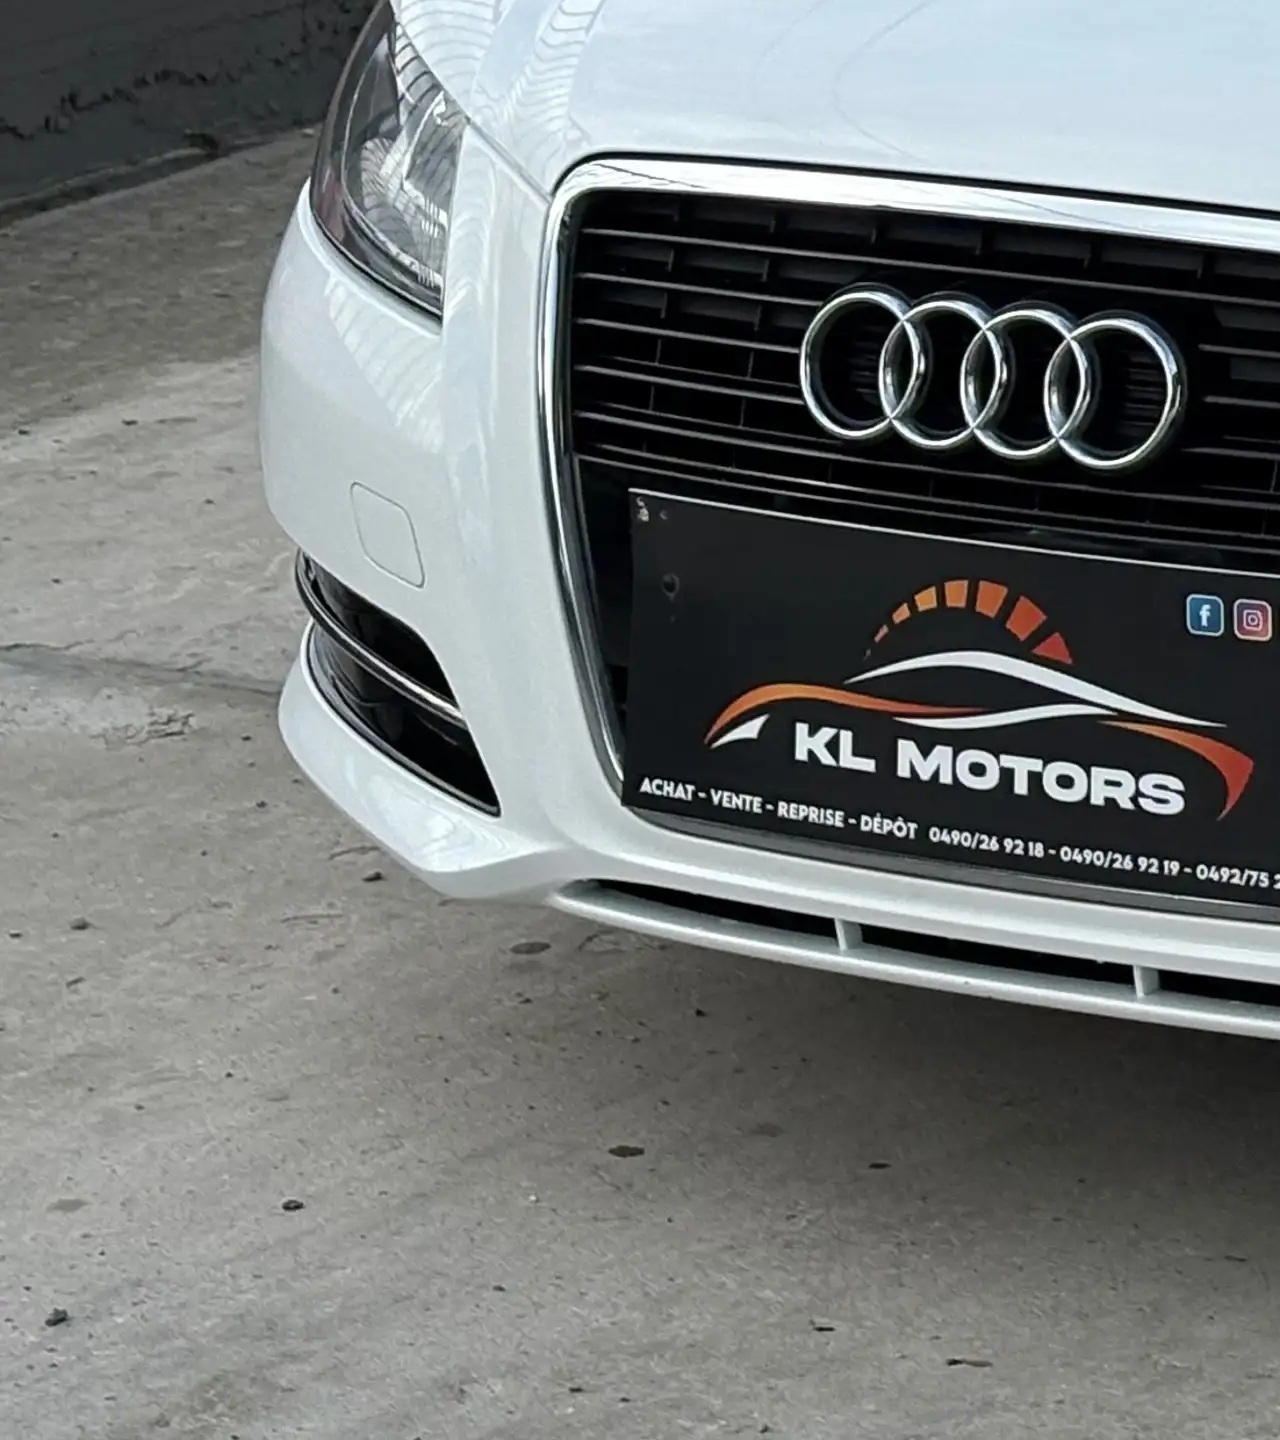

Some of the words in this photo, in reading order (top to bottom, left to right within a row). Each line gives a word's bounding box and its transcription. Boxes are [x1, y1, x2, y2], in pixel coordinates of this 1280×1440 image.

[794, 721, 877, 773] KL
[896, 738, 1186, 815] MOTORS
[639, 777, 696, 801] ACHAT
[710, 788, 763, 814] VENTE
[777, 800, 845, 828] REPRISE
[860, 812, 919, 840] DÉPÔT
[928, 826, 1000, 852] 0490/26
[1003, 837, 1025, 856] 92
[1027, 841, 1045, 858] 18
[1059, 845, 1134, 871] 0490/26
[1137, 856, 1160, 874] 92
[1163, 859, 1181, 877] 19
[1195, 863, 1270, 888] 0492/75
